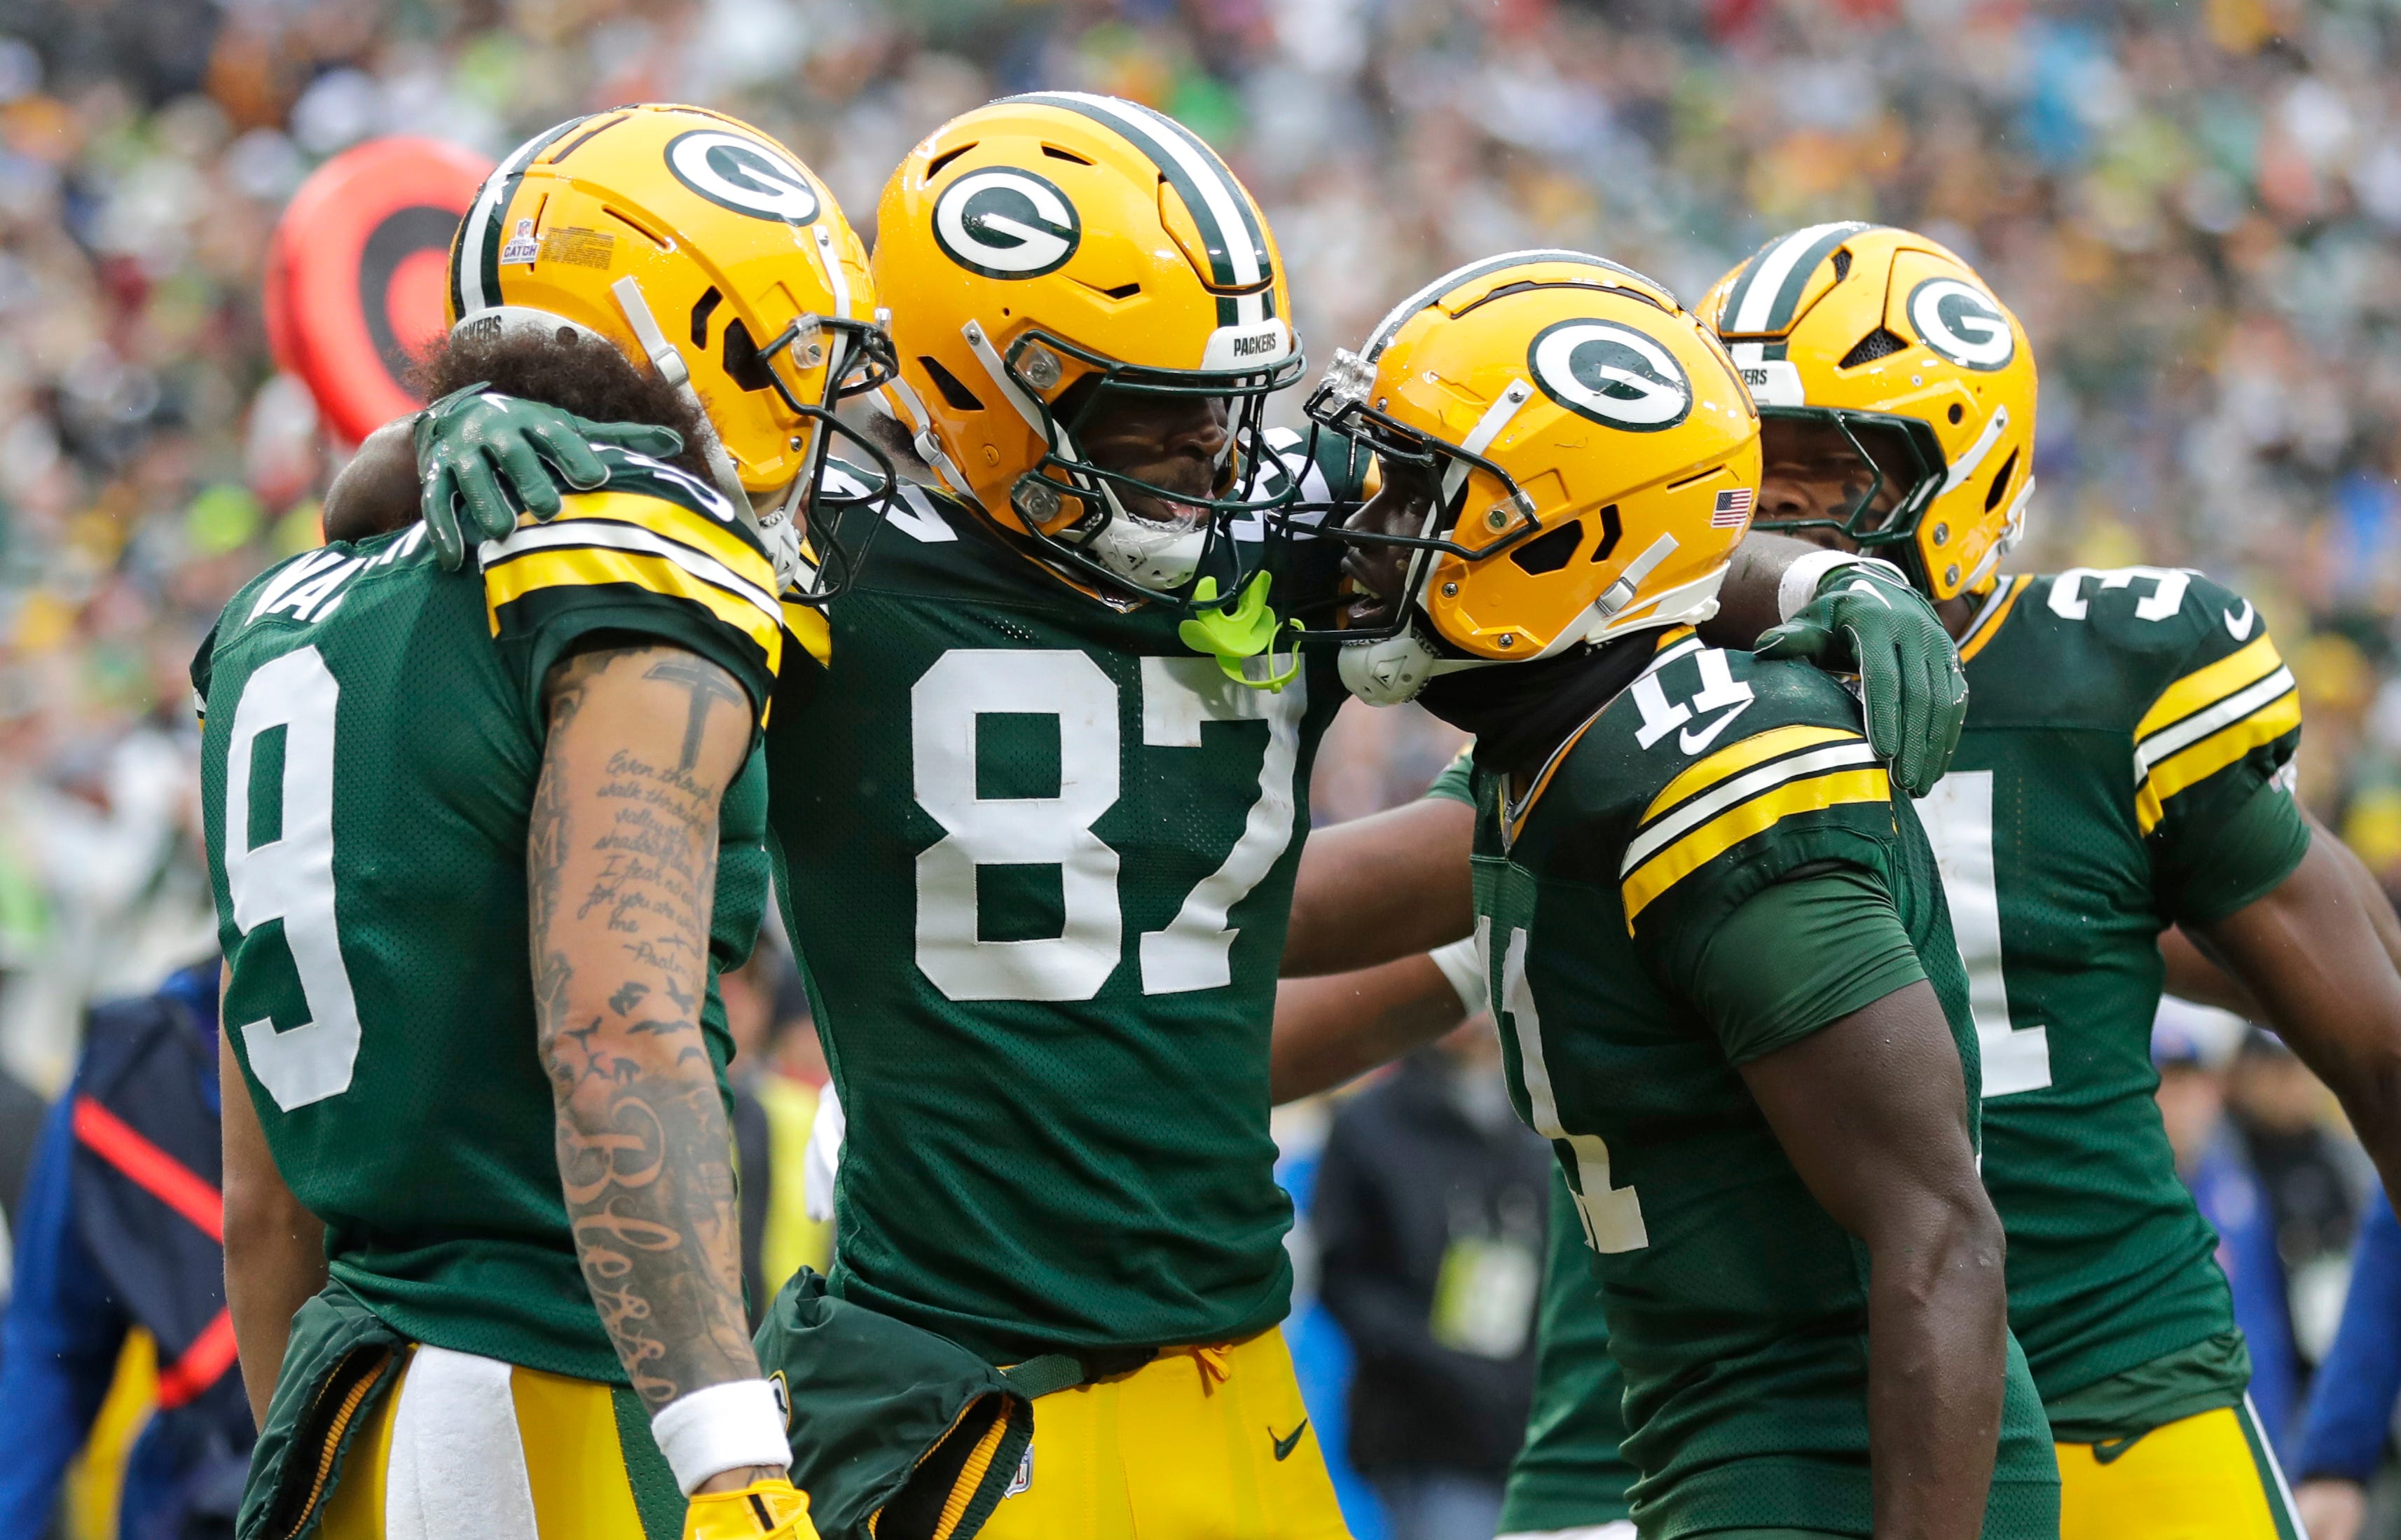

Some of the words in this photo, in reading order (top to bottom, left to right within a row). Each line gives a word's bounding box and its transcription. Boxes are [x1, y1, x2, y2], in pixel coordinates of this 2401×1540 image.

[503, 245, 537, 257] CATCH
[1234, 332, 1277, 357] PACKERS
[1631, 647, 1754, 751] 11
[911, 649, 1308, 1001] 87
[225, 645, 362, 1113] 9
